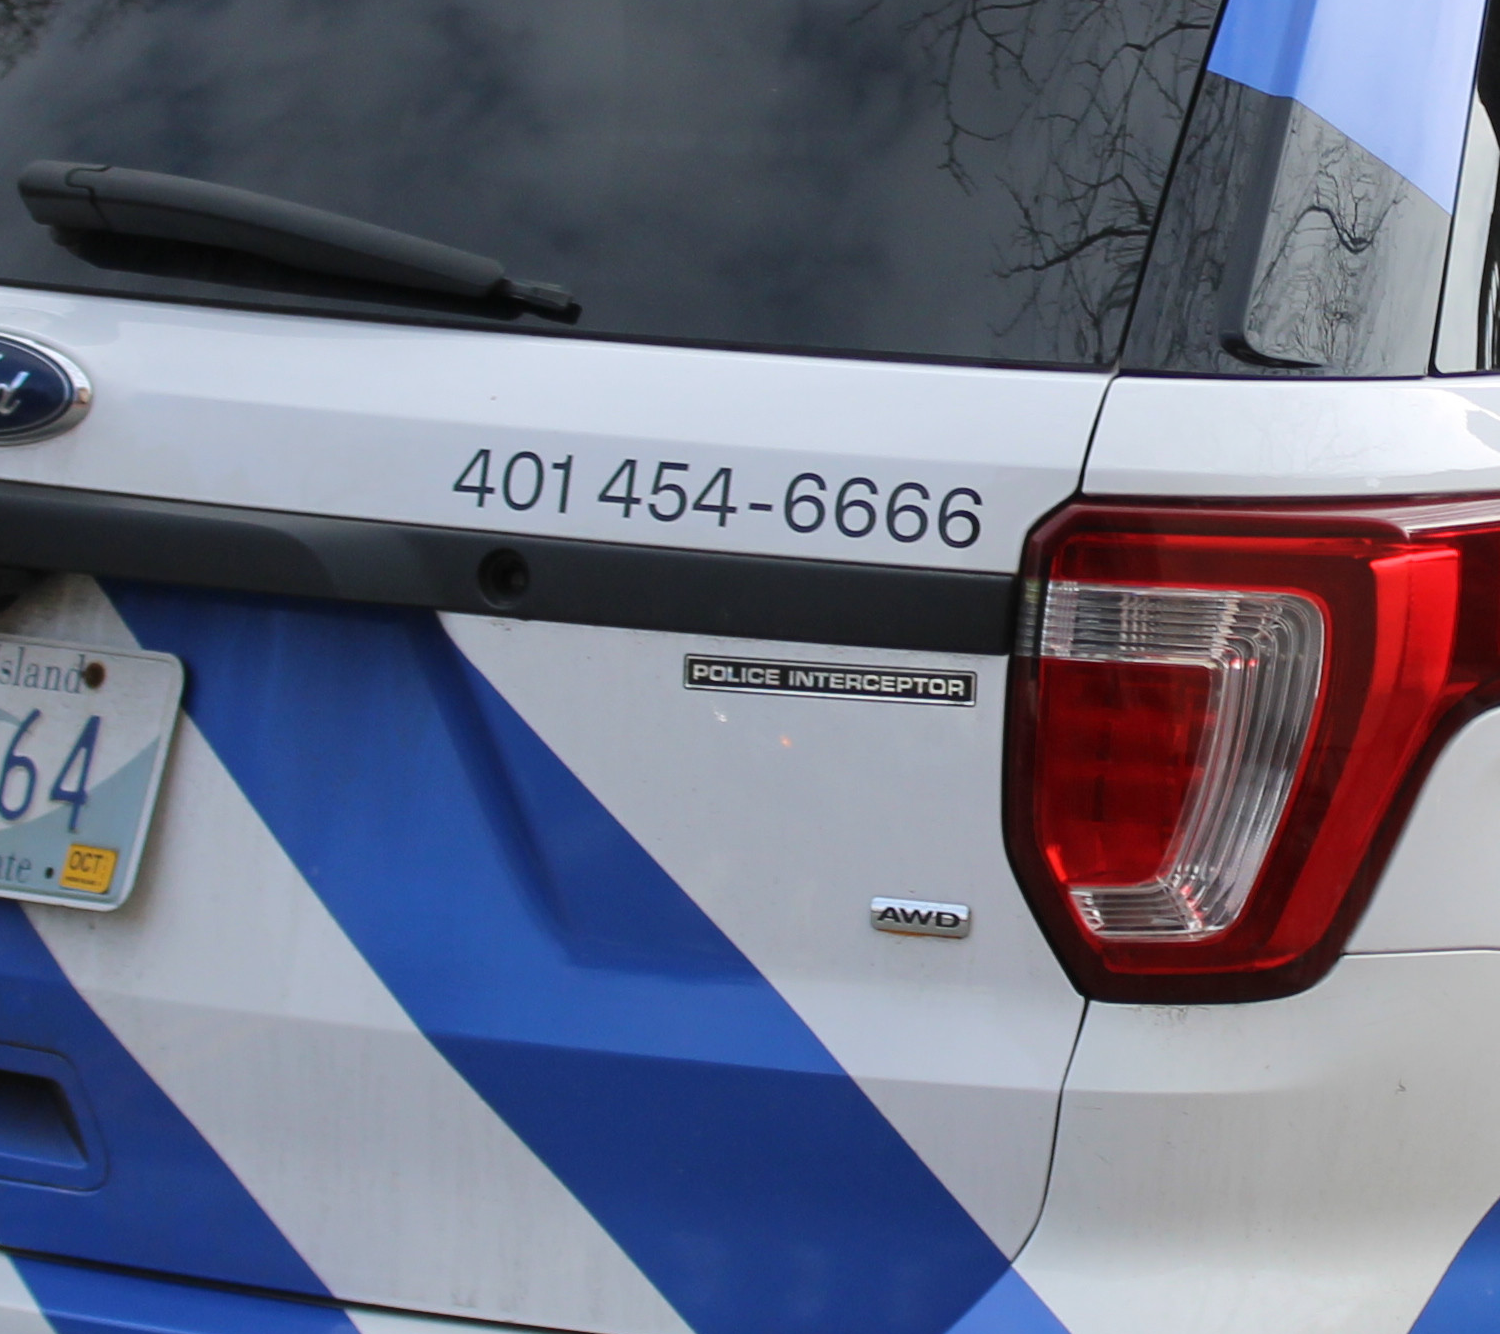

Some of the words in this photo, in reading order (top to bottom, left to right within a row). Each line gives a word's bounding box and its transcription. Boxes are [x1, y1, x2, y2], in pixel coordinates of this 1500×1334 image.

[452, 448, 575, 514] 401
[597, 458, 984, 549] 454-6666
[692, 663, 781, 686] POLICE
[788, 669, 966, 697] INTERCEPTOR
[69, 850, 104, 874] OCT
[876, 906, 961, 928] AWD
